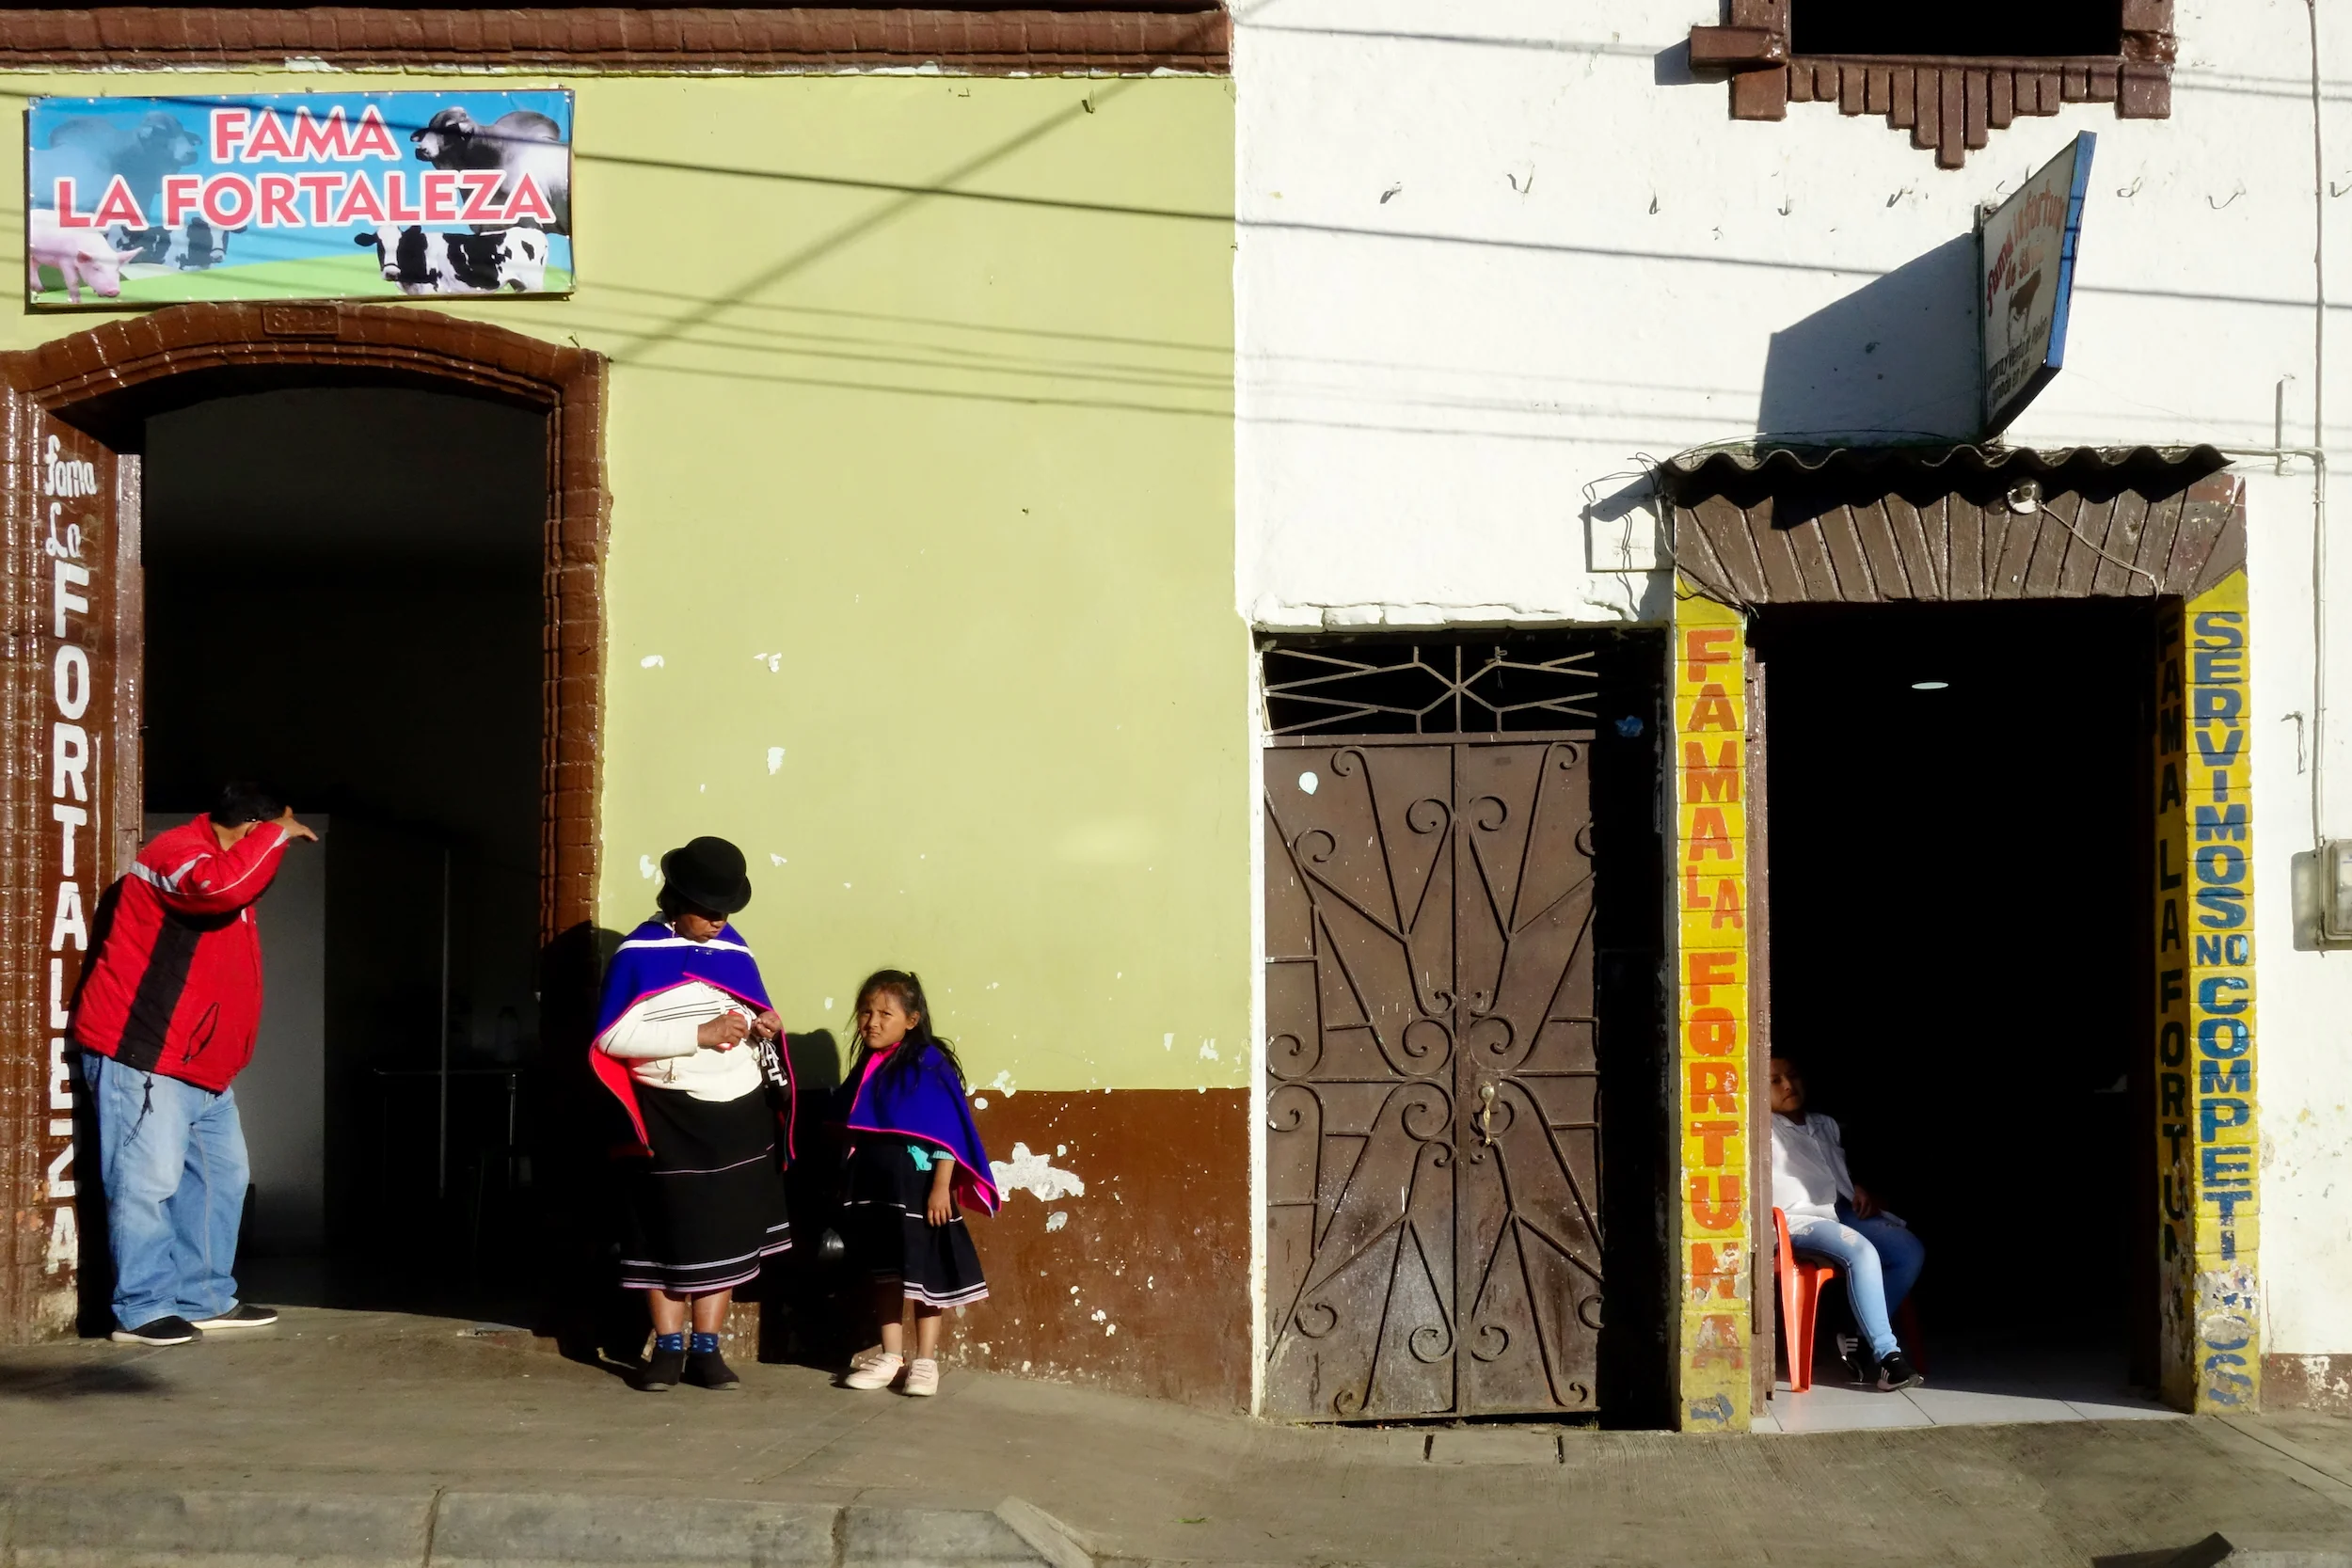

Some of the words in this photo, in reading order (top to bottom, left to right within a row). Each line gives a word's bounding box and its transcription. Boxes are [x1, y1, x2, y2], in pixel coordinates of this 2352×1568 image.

[214, 105, 400, 161] FAMA
[56, 174, 147, 230] LA
[165, 171, 555, 229] FORTALEZA
[44, 434, 97, 498] fama
[45, 501, 82, 559] La
[1686, 628, 1740, 862] FAMA
[2157, 609, 2183, 815] FAMA
[2192, 611, 2247, 929] SERVIMOS
[44, 560, 90, 1275] FORTALEZA
[1685, 865, 1743, 929] LA
[2159, 838, 2183, 955] LA
[2196, 930, 2249, 967] NO
[2196, 975, 2253, 1406] COMPETIS
